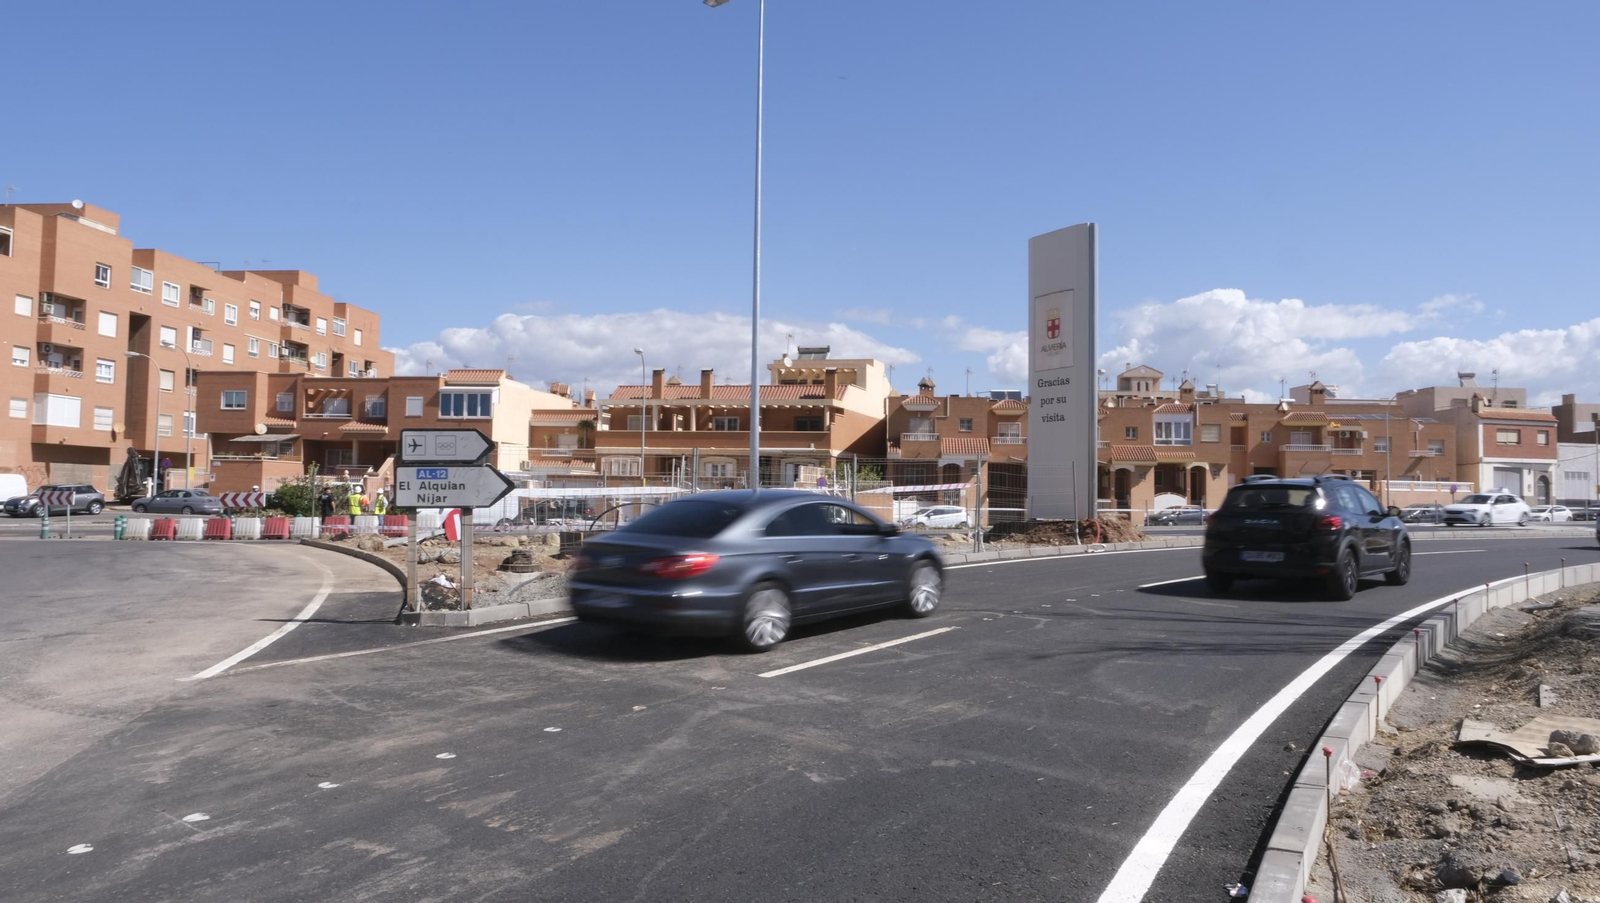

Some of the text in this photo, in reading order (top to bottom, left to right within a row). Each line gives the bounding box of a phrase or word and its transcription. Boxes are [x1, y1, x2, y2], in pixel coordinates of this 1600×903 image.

[1037, 377, 1070, 388] Gracias
[1040, 396, 1067, 407] por su
[1041, 413, 1065, 422] visita
[418, 470, 447, 478] AL-12
[399, 481, 411, 491] El
